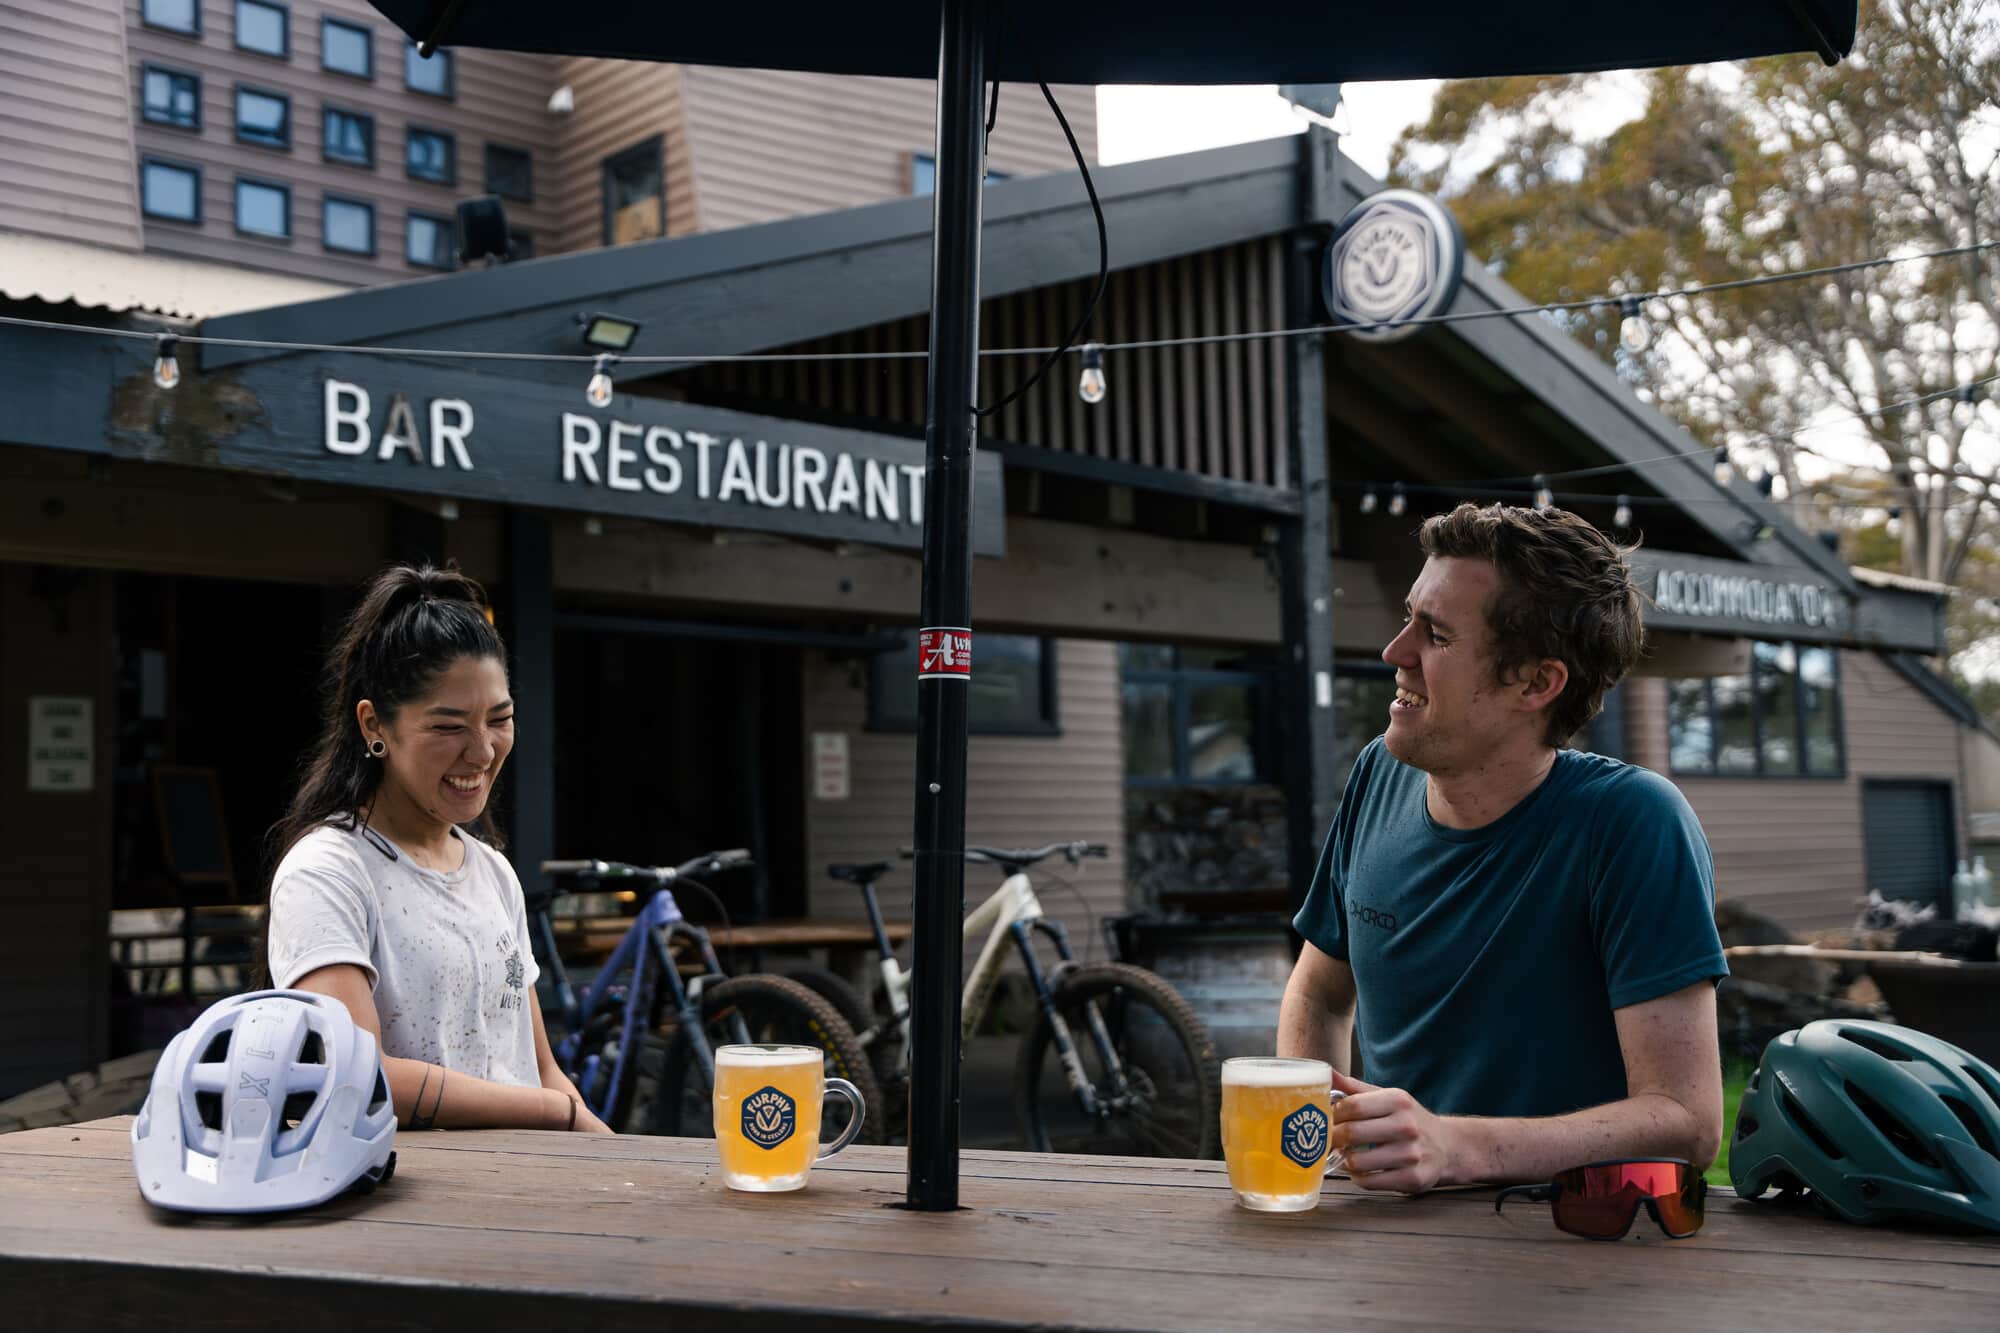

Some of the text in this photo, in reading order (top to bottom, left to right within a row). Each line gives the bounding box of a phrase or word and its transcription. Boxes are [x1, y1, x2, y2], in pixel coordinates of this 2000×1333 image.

[324, 378, 927, 527] BAR RESTAURANT
[746, 1092, 792, 1114] FURPHY
[1287, 1110, 1326, 1132] FURPHY
